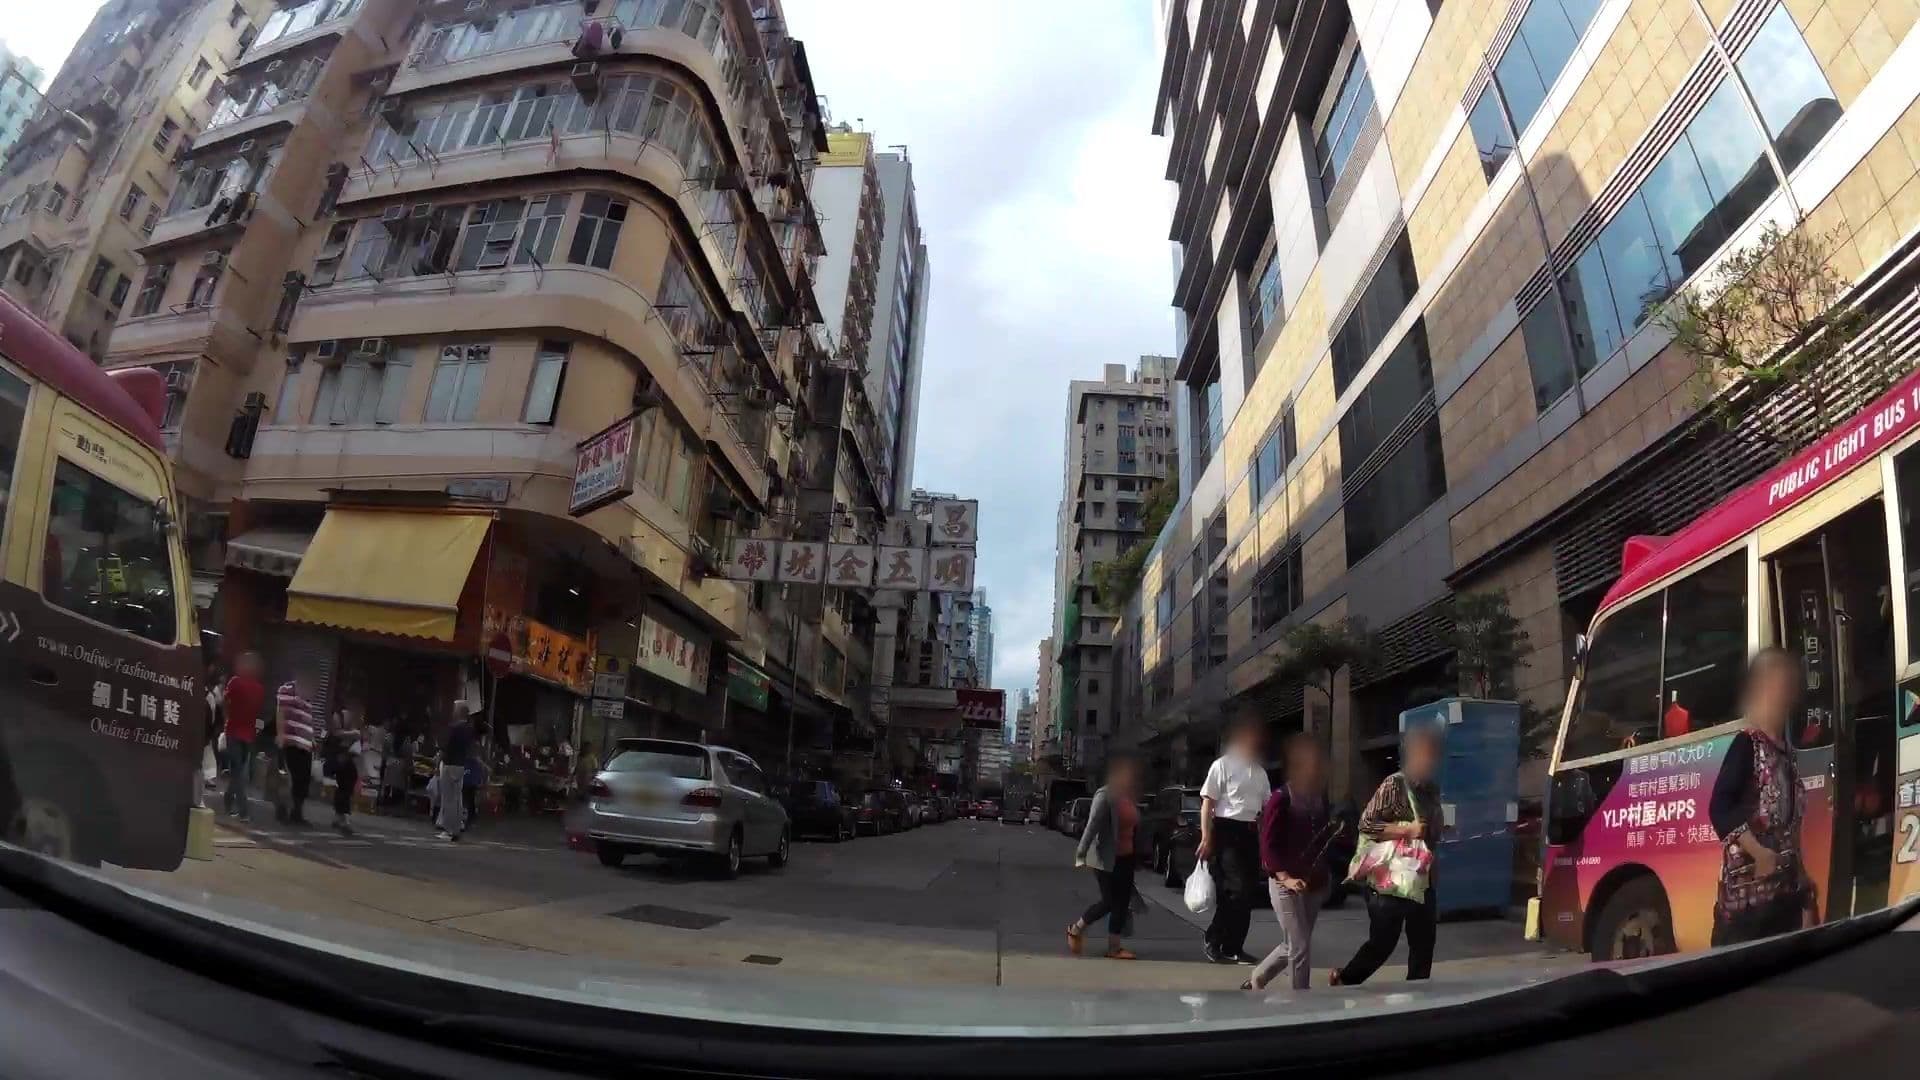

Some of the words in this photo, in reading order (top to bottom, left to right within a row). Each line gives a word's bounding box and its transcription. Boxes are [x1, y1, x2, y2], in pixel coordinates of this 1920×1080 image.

[1768, 456, 1820, 506] PUBLIC
[1824, 427, 1868, 471] LIGHT
[1873, 397, 1905, 439] BUS
[91, 680, 181, 726] 網上時裝
[90, 716, 130, 740] Online
[133, 726, 180, 751] Fashion
[1603, 798, 1697, 829] YLP村屋APPS
